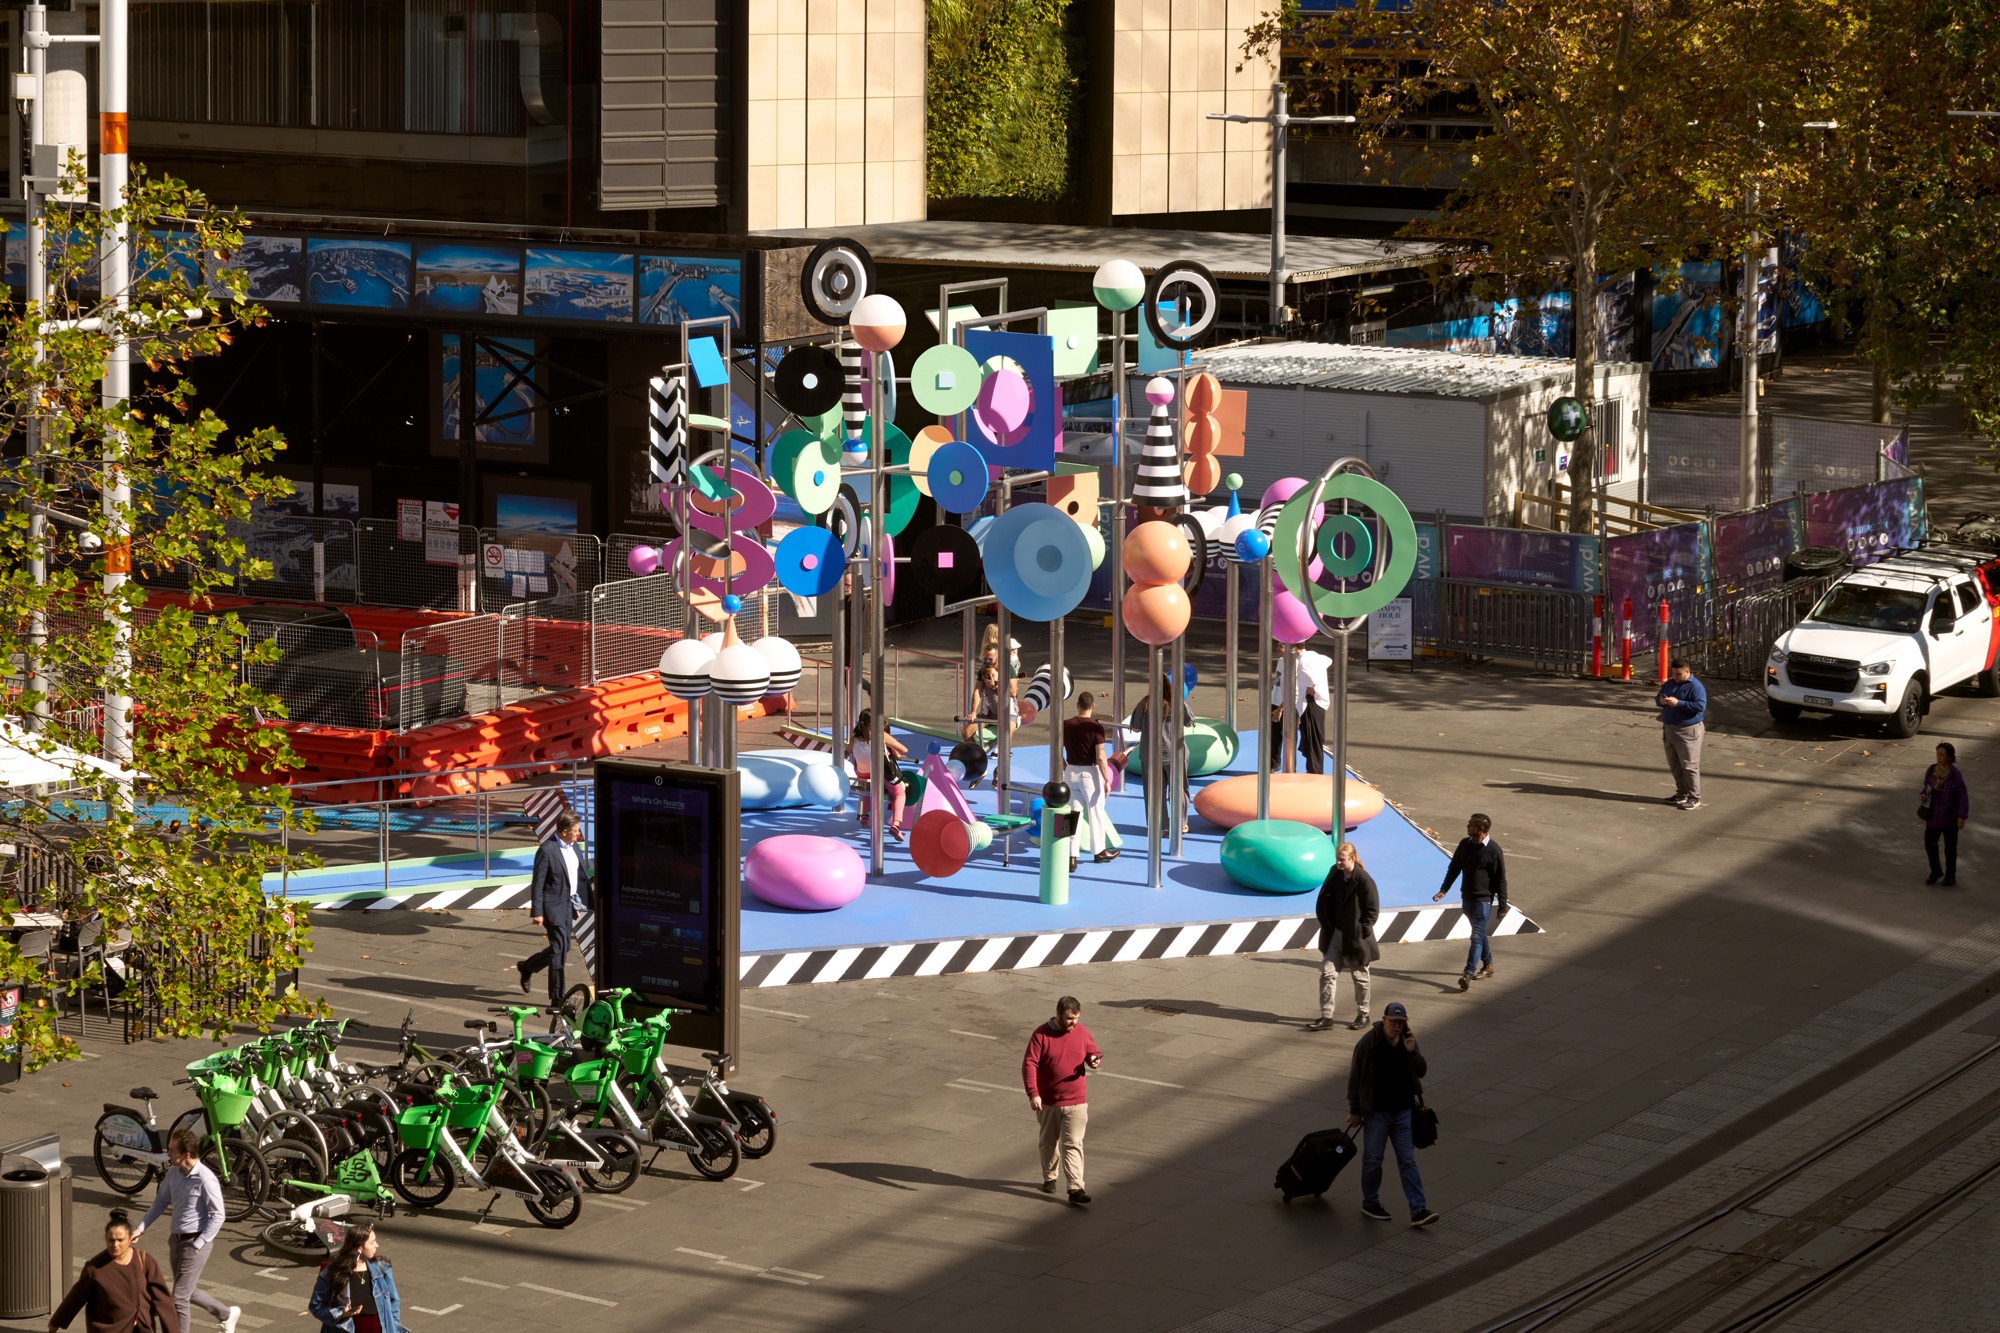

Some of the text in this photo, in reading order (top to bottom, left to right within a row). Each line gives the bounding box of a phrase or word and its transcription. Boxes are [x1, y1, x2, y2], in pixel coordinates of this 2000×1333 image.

[1352, 328, 1385, 345] SITE ENTRY
[645, 725, 661, 735] Coates
[552, 751, 569, 760] Coates
[632, 795, 685, 809] What's On Nearby
[621, 885, 648, 897] Astronomy
[655, 889, 665, 897] The
[666, 891, 680, 899] Calyx
[642, 976, 651, 984] CITY
[656, 977, 672, 987] SYDNEY
[448, 1150, 467, 1175] Lime
